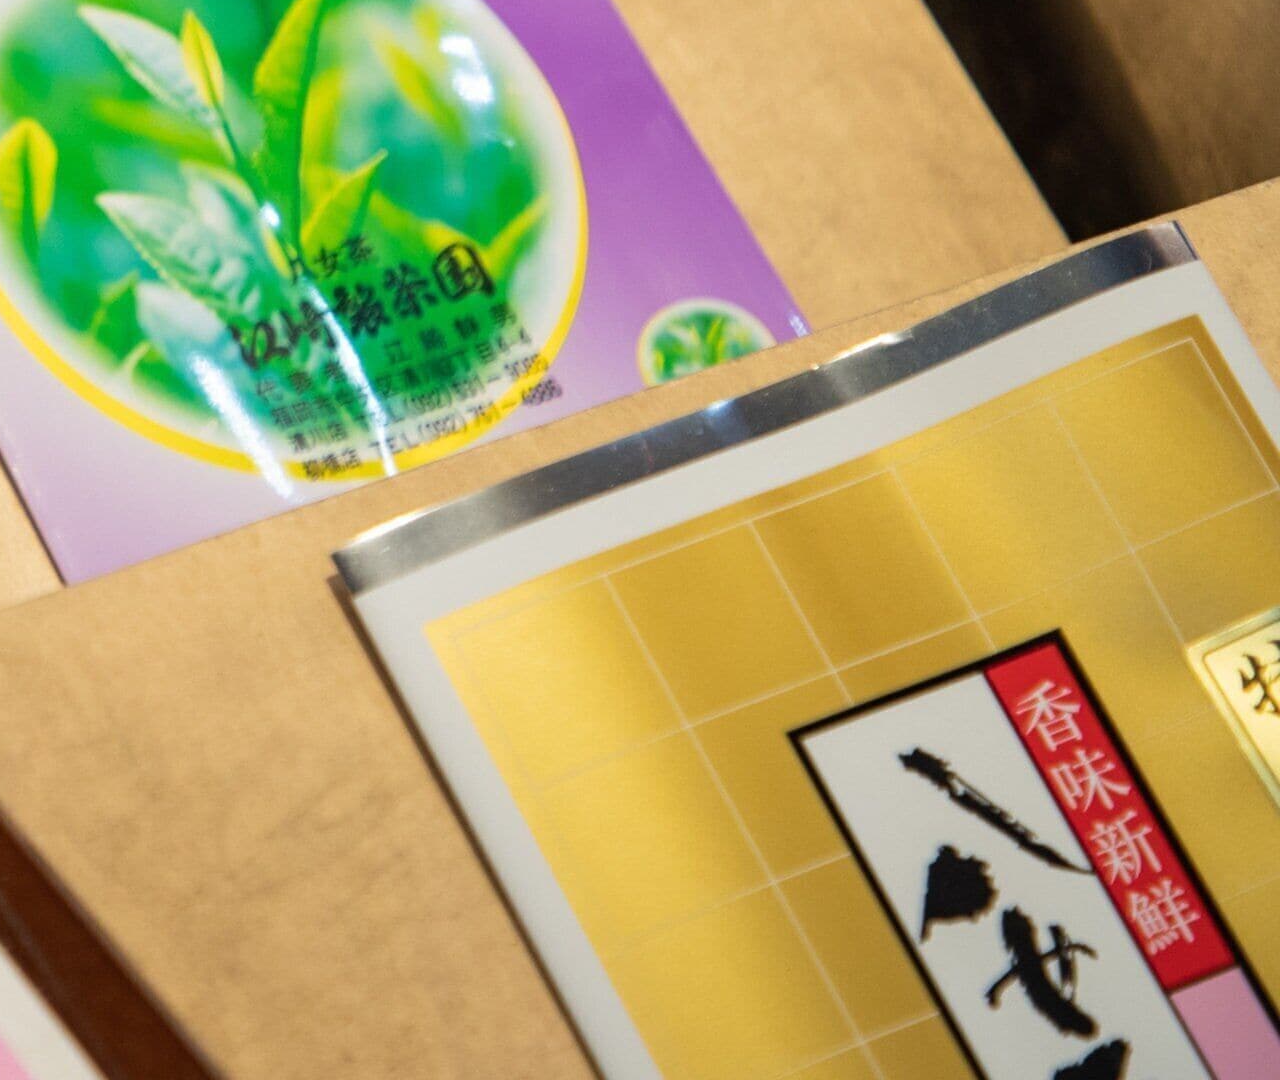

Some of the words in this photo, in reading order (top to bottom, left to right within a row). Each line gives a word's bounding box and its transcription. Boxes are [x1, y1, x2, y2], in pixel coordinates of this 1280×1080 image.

[896, 747, 1134, 1080] 八女
[1014, 679, 1203, 955] 香味新鮮
